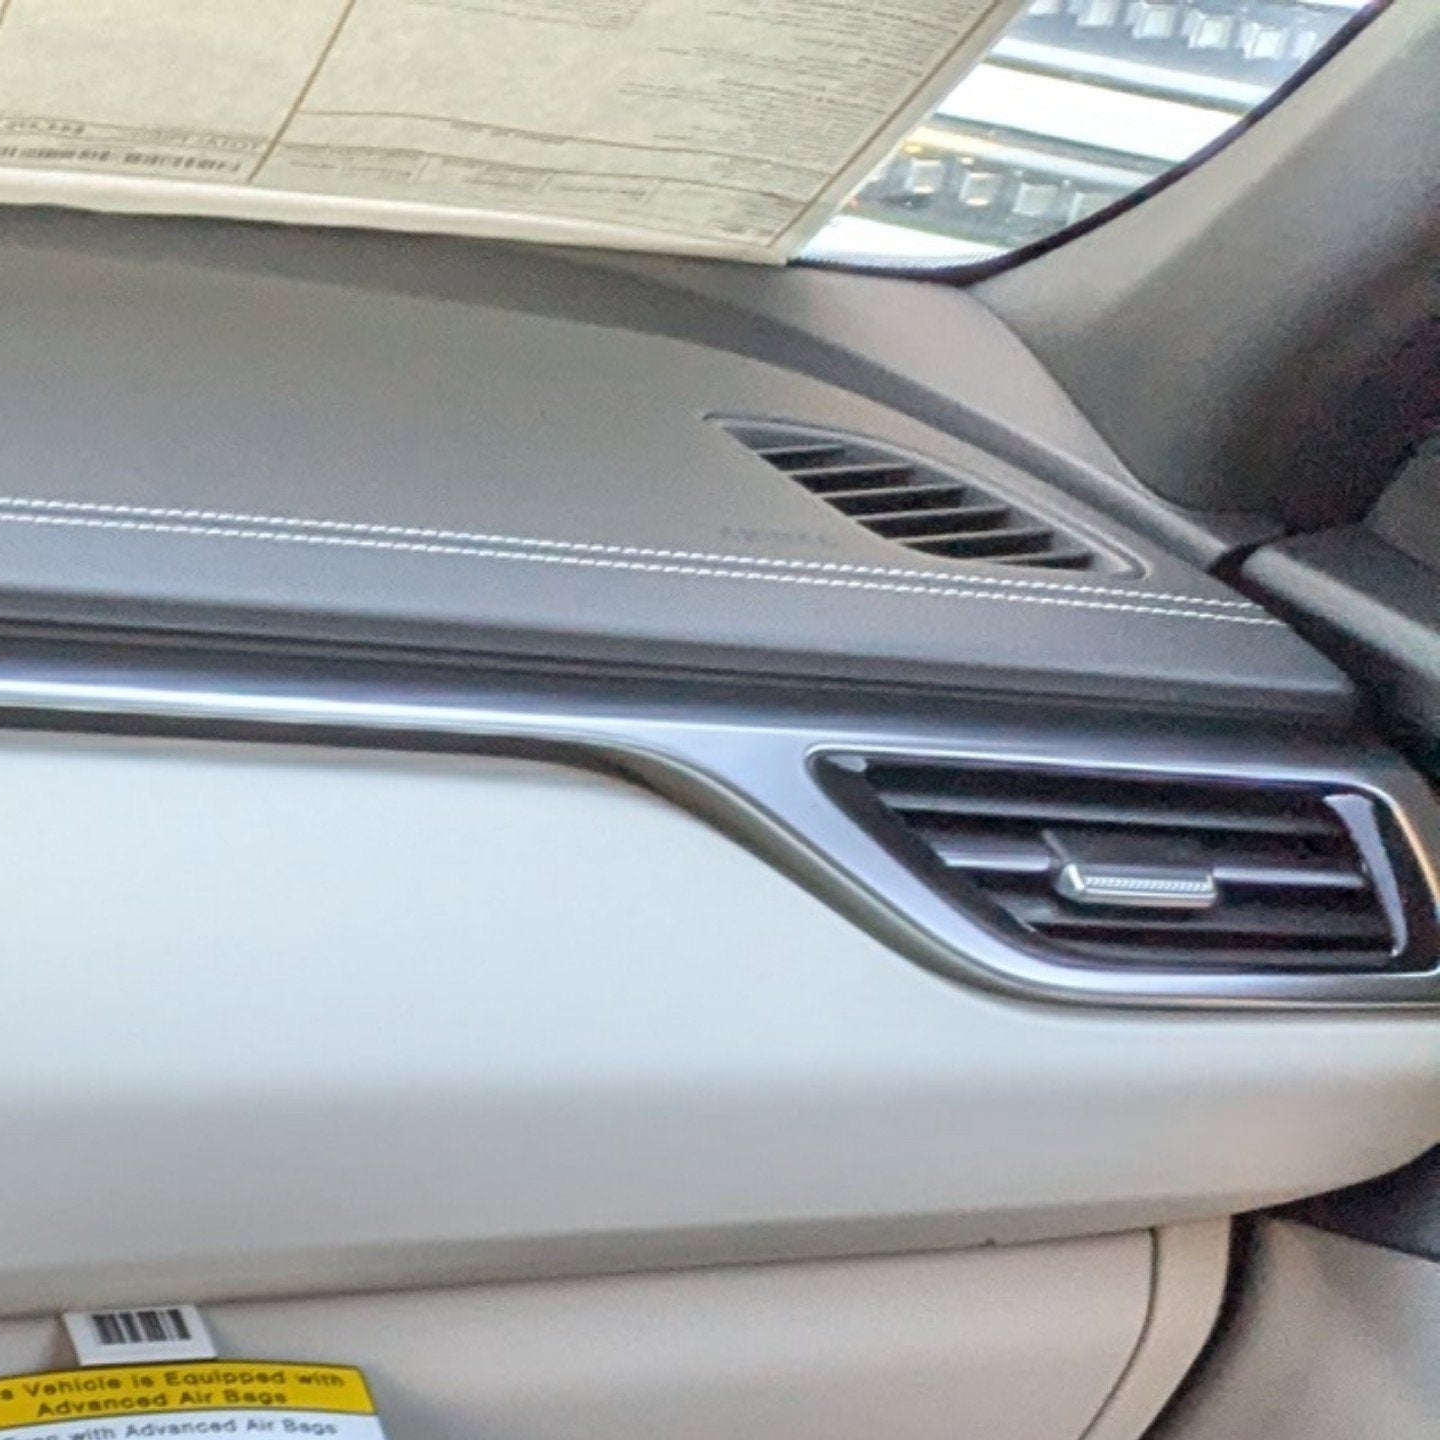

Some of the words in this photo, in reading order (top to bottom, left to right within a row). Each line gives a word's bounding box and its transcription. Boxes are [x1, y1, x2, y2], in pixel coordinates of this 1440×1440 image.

[23, 1376, 121, 1397] Vehicle
[132, 1375, 154, 1388] is
[164, 1369, 286, 1387] Equipped
[296, 1372, 345, 1387] with
[37, 1393, 168, 1417] Advanced
[180, 1390, 213, 1405] Air
[222, 1389, 287, 1406] Bags
[126, 1418, 237, 1438] Advanced
[247, 1418, 274, 1432] Air
[283, 1418, 337, 1436] Bags
